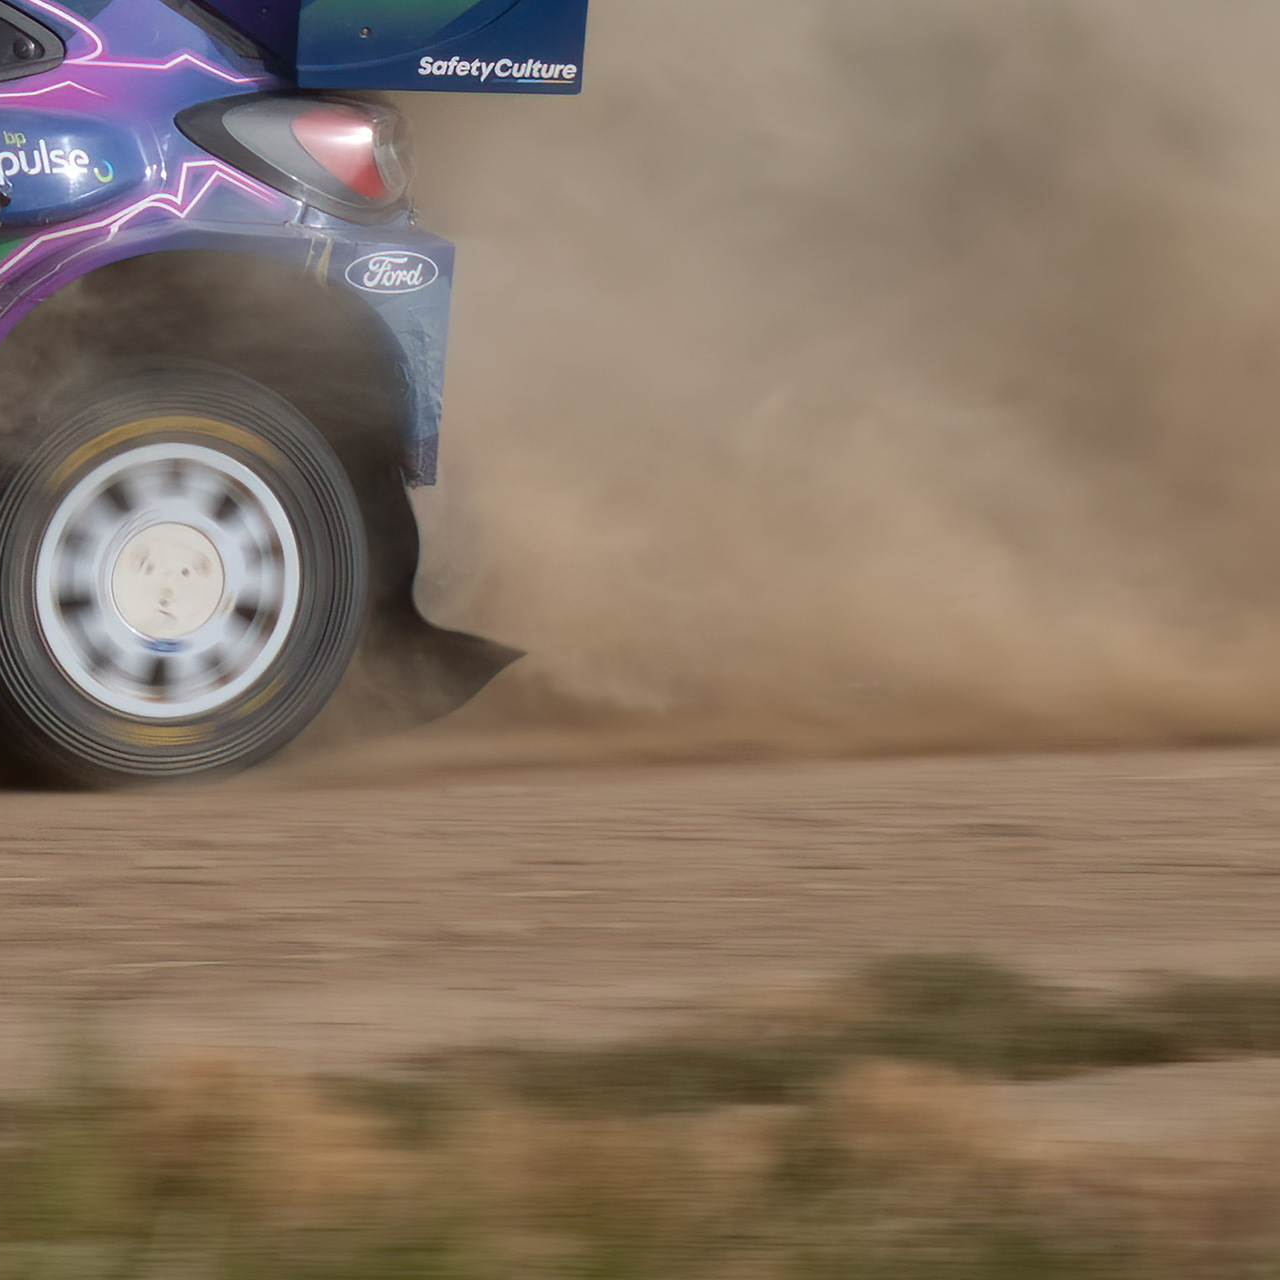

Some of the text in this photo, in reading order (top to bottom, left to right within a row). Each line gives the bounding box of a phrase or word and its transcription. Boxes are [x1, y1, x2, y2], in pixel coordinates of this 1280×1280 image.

[418, 55, 577, 82] SafetyCulture
[2, 130, 27, 148] bp
[362, 255, 425, 289] Ford
